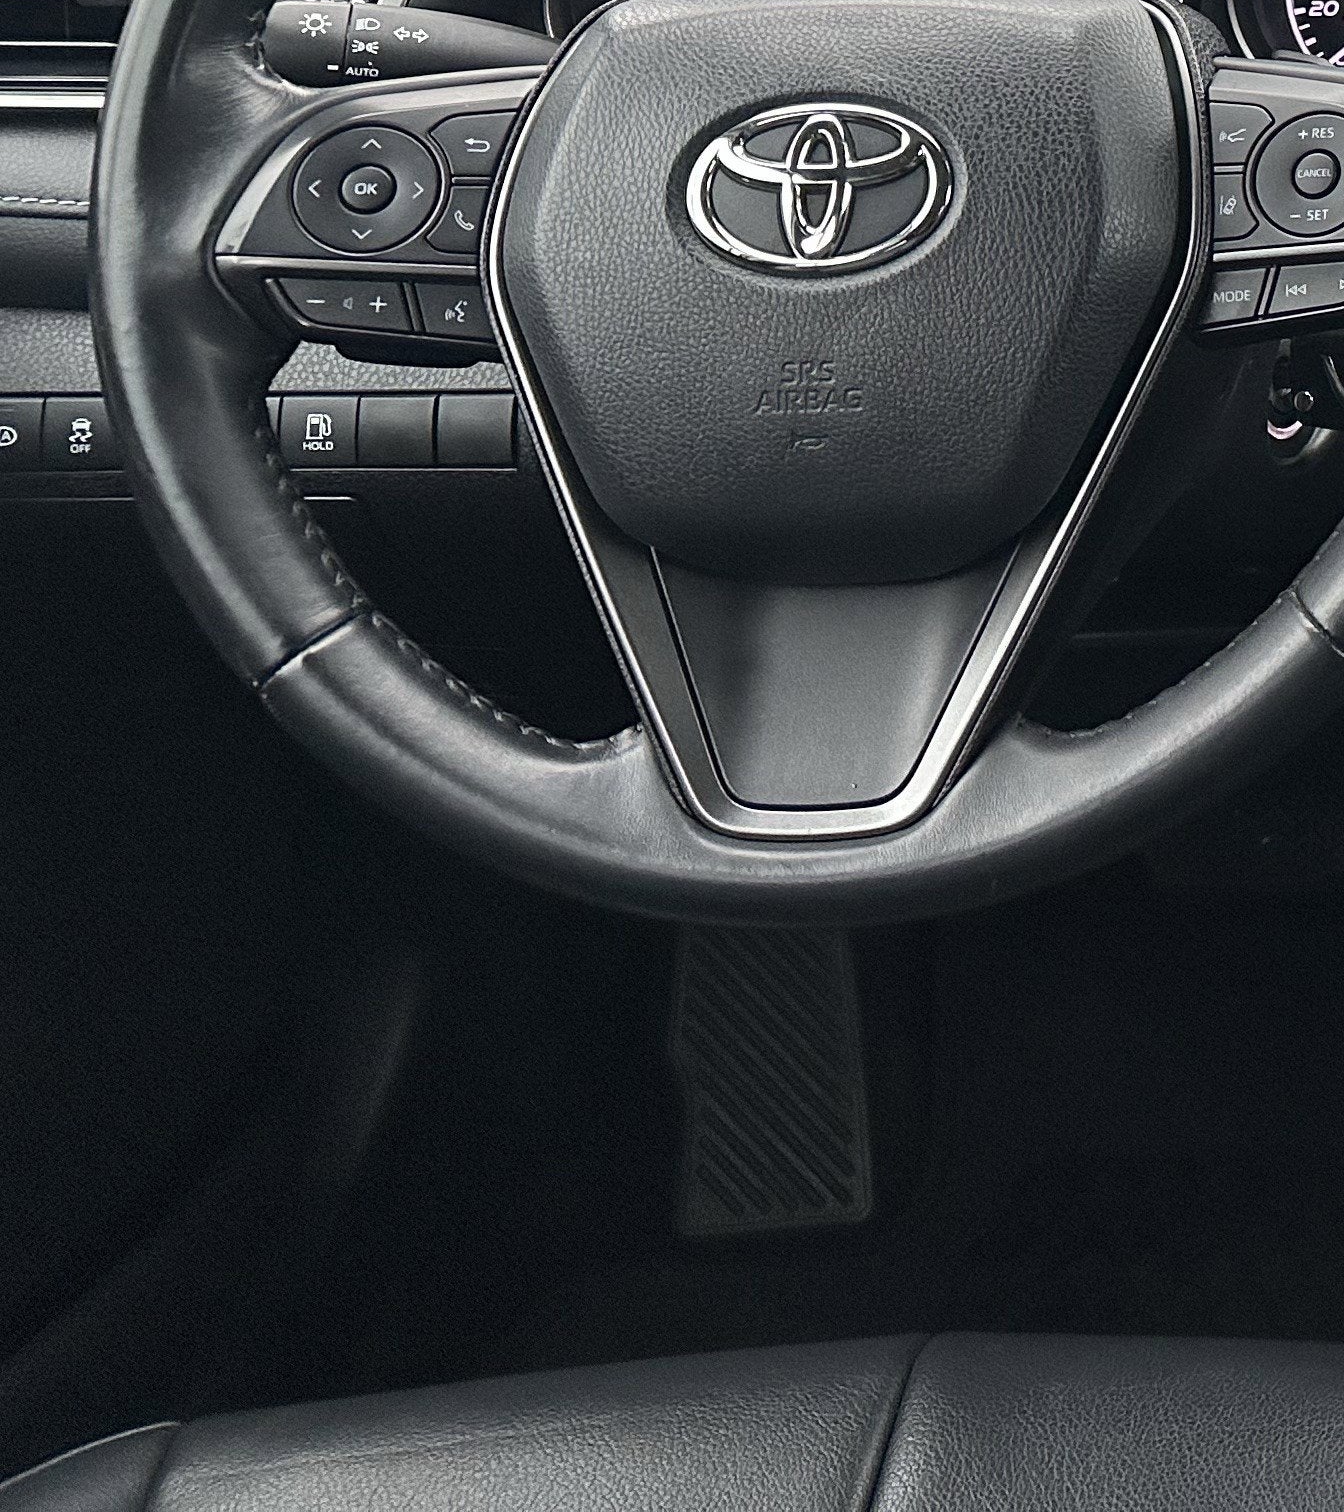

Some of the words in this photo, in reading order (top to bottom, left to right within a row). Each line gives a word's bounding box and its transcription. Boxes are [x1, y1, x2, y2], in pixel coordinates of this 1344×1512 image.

[1308, 0, 1340, 17] 20
[345, 65, 380, 77] AUTO
[1311, 126, 1335, 140] RES
[1296, 166, 1332, 179] CANCEL
[354, 182, 378, 196] OK
[1306, 208, 1329, 221] SET
[1212, 288, 1252, 304] MODE
[780, 360, 836, 387] SRS
[750, 387, 864, 415] AIRBAG
[70, 443, 92, 453] OFF
[302, 441, 334, 451] HOLD
